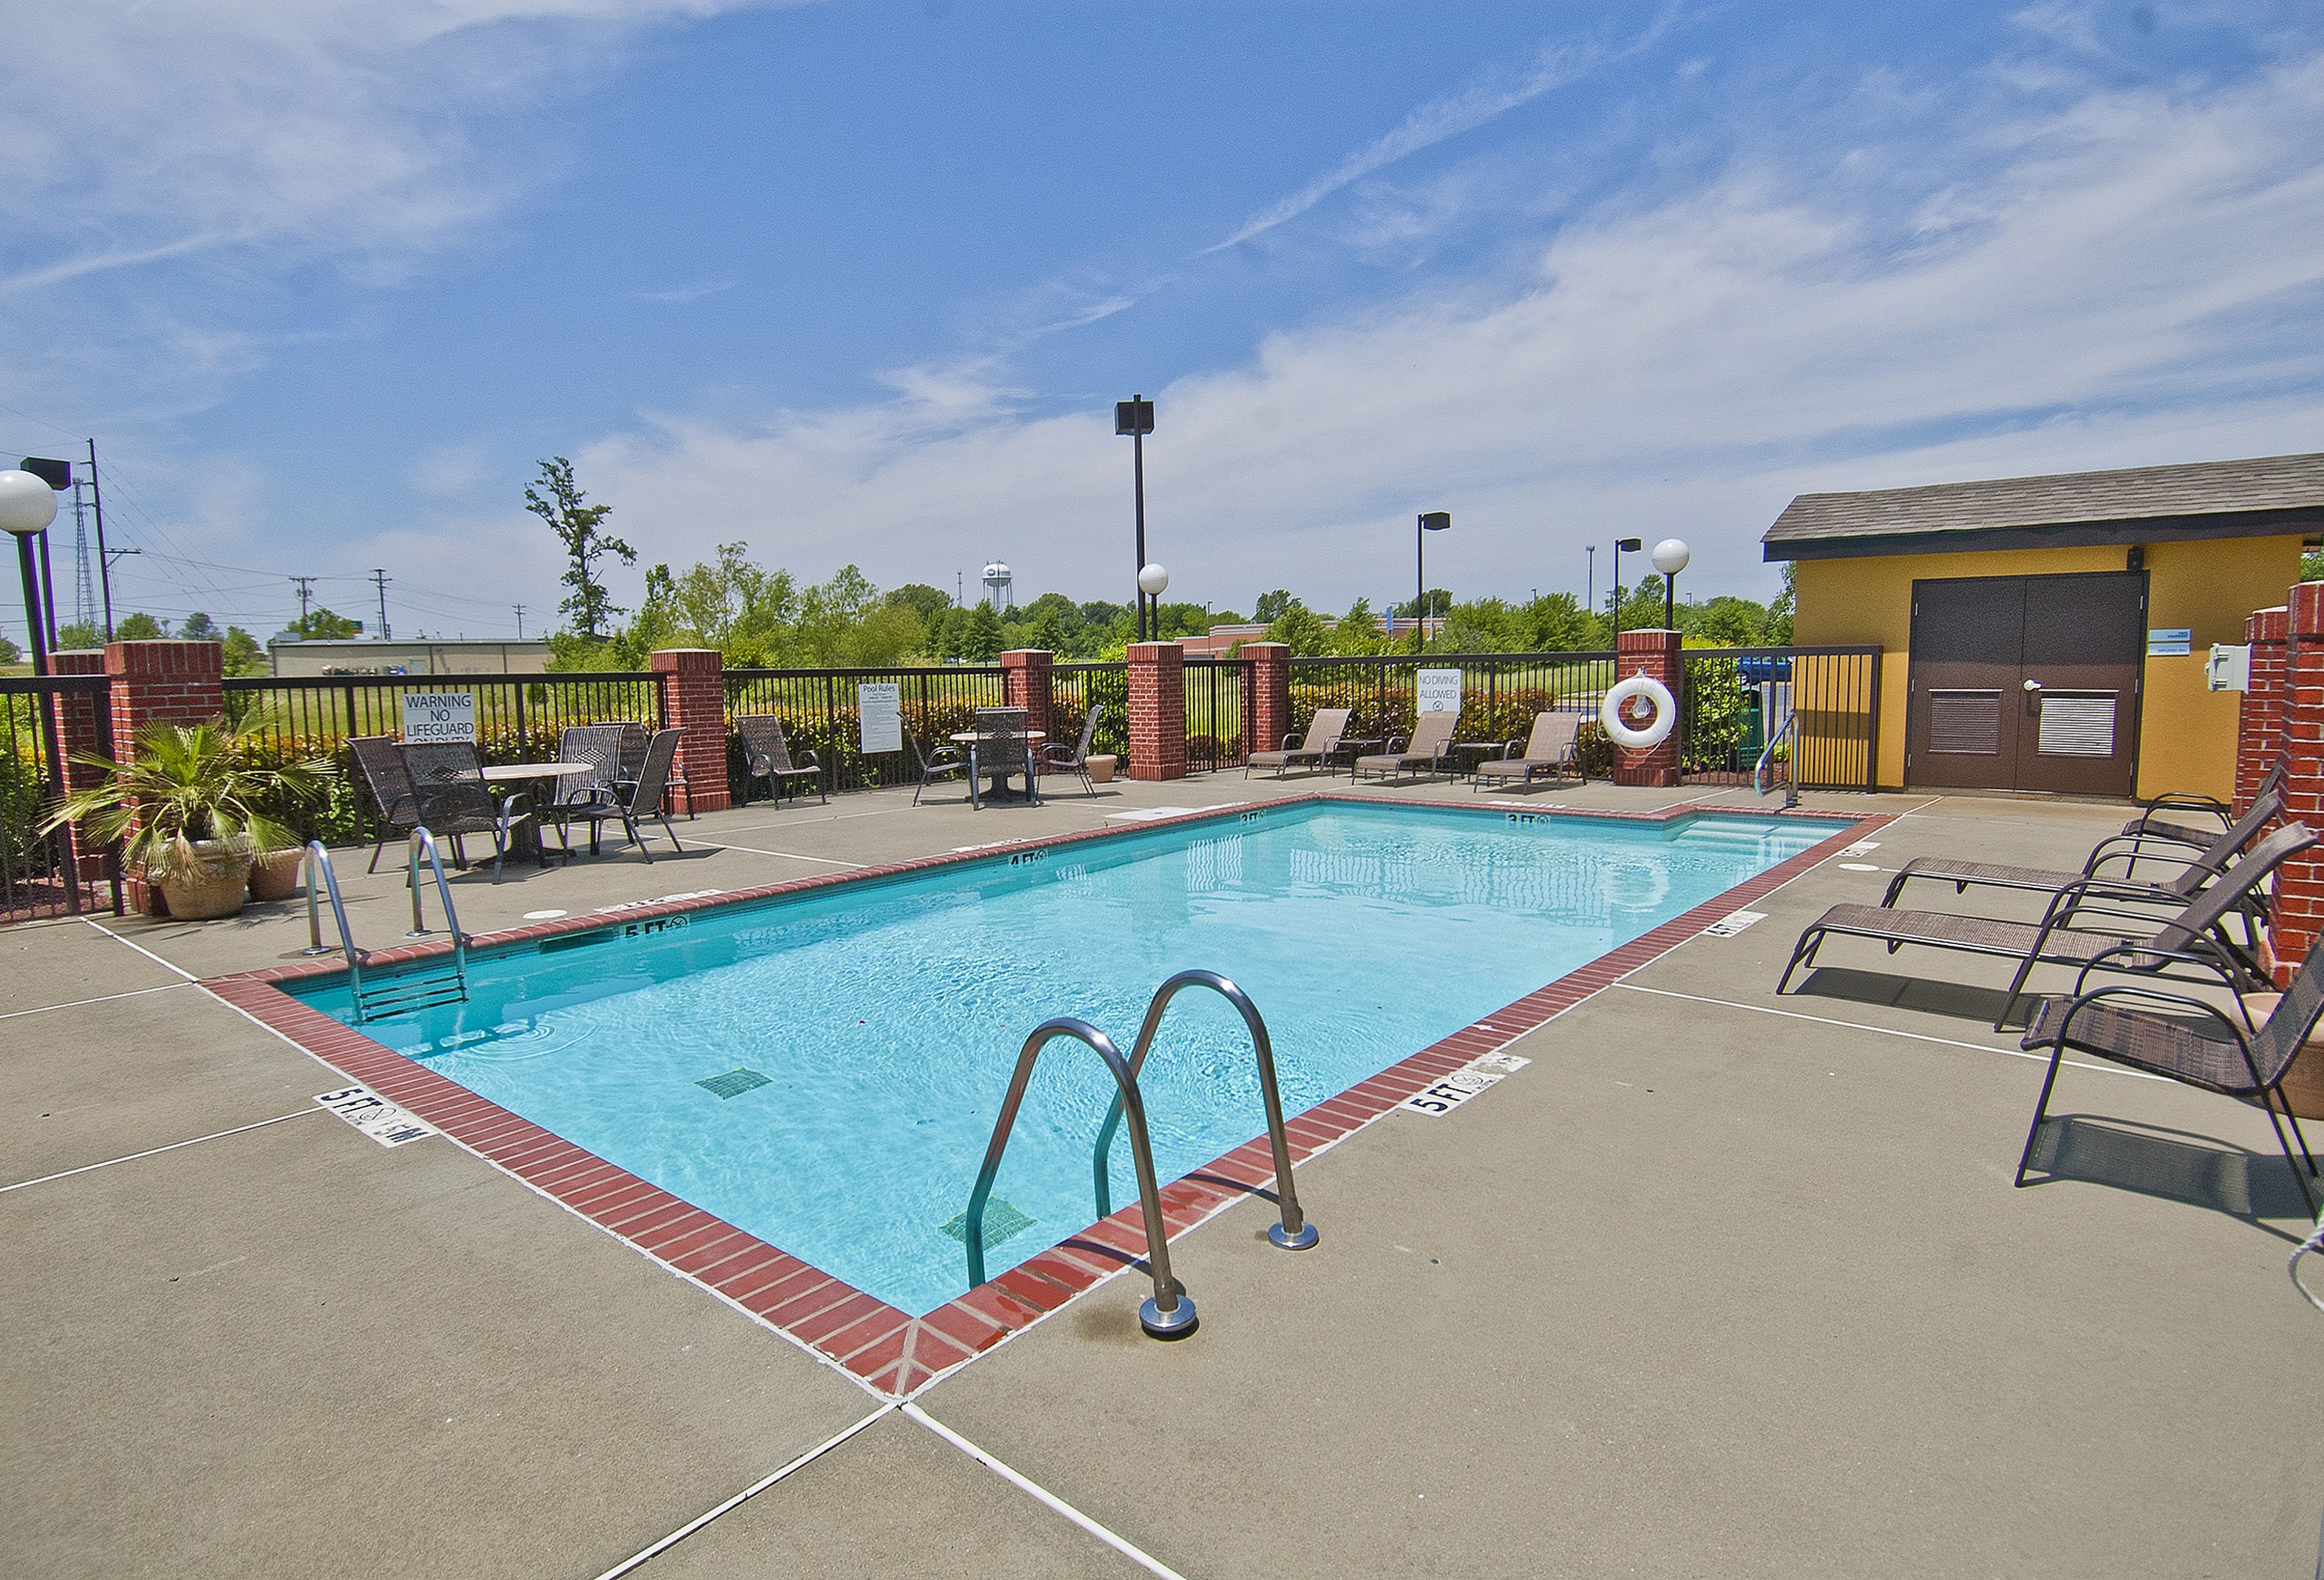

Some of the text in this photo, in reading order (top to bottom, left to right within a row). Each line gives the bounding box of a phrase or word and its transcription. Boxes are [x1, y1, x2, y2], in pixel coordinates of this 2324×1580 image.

[1419, 675, 1458, 685] NO DIVING
[1420, 689, 1457, 699] ALLOWED
[405, 695, 471, 708] WARNING
[430, 709, 450, 722] NO
[406, 722, 474, 737] LIFEGUARD
[1521, 814, 1535, 823] FT
[624, 920, 666, 938] 5 FT
[320, 1088, 364, 1101] 5
[1426, 1083, 1473, 1102] FT
[332, 1097, 384, 1114] FT
[1410, 1098, 1448, 1112] 5
